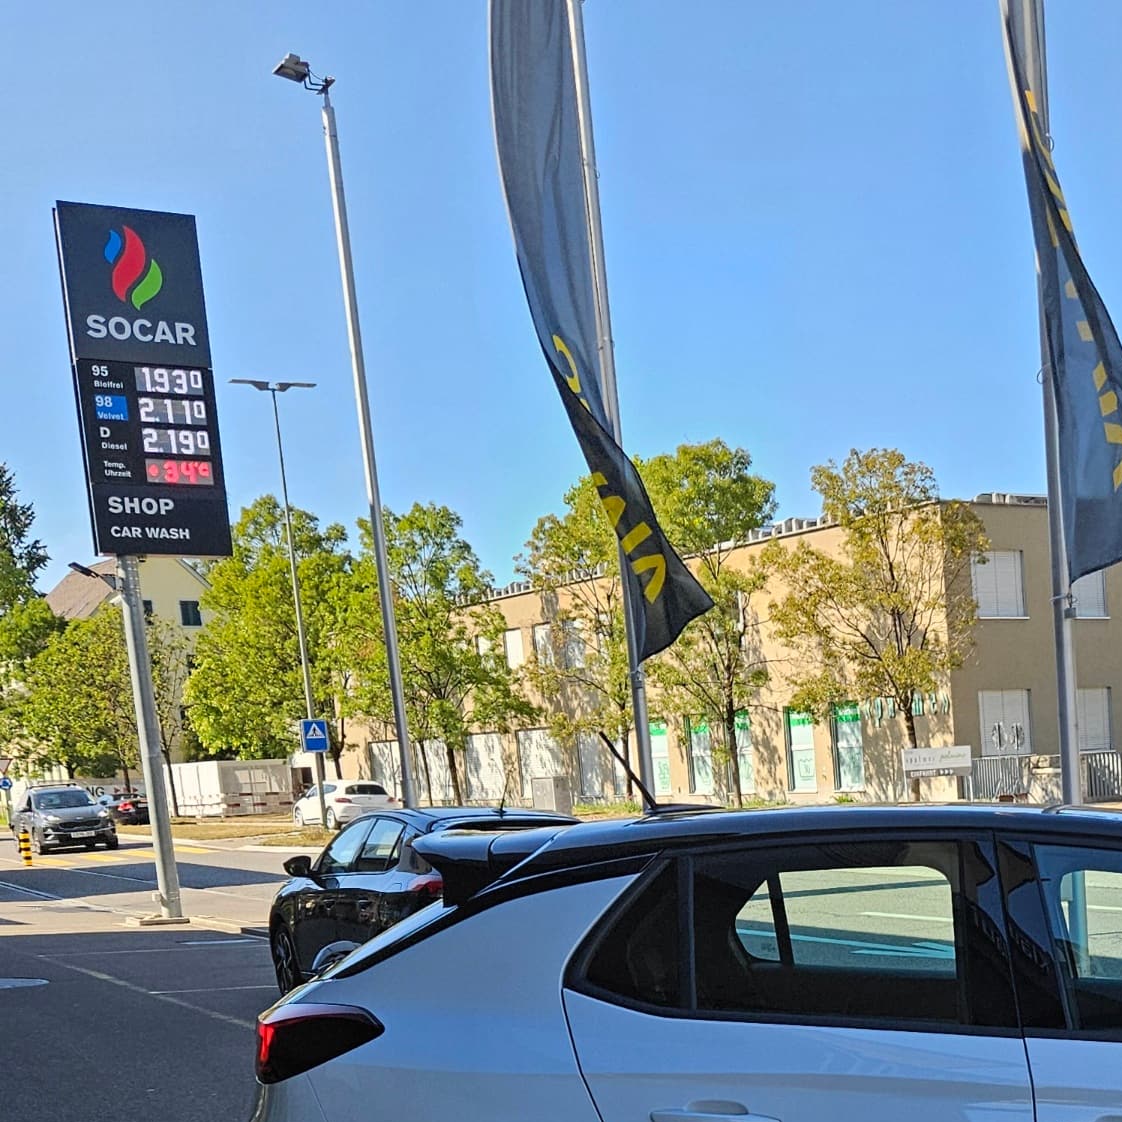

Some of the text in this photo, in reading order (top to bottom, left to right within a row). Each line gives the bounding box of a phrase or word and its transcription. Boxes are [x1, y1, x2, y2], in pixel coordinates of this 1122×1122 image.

[86, 314, 197, 346] SOCAR
[91, 365, 109, 377] 95
[95, 396, 113, 408] 98
[99, 427, 111, 438] D
[101, 442, 128, 450] Diesel
[104, 469, 132, 478] Uhrzeit
[107, 496, 175, 515] SHOP
[110, 526, 191, 539] CAR WASH
